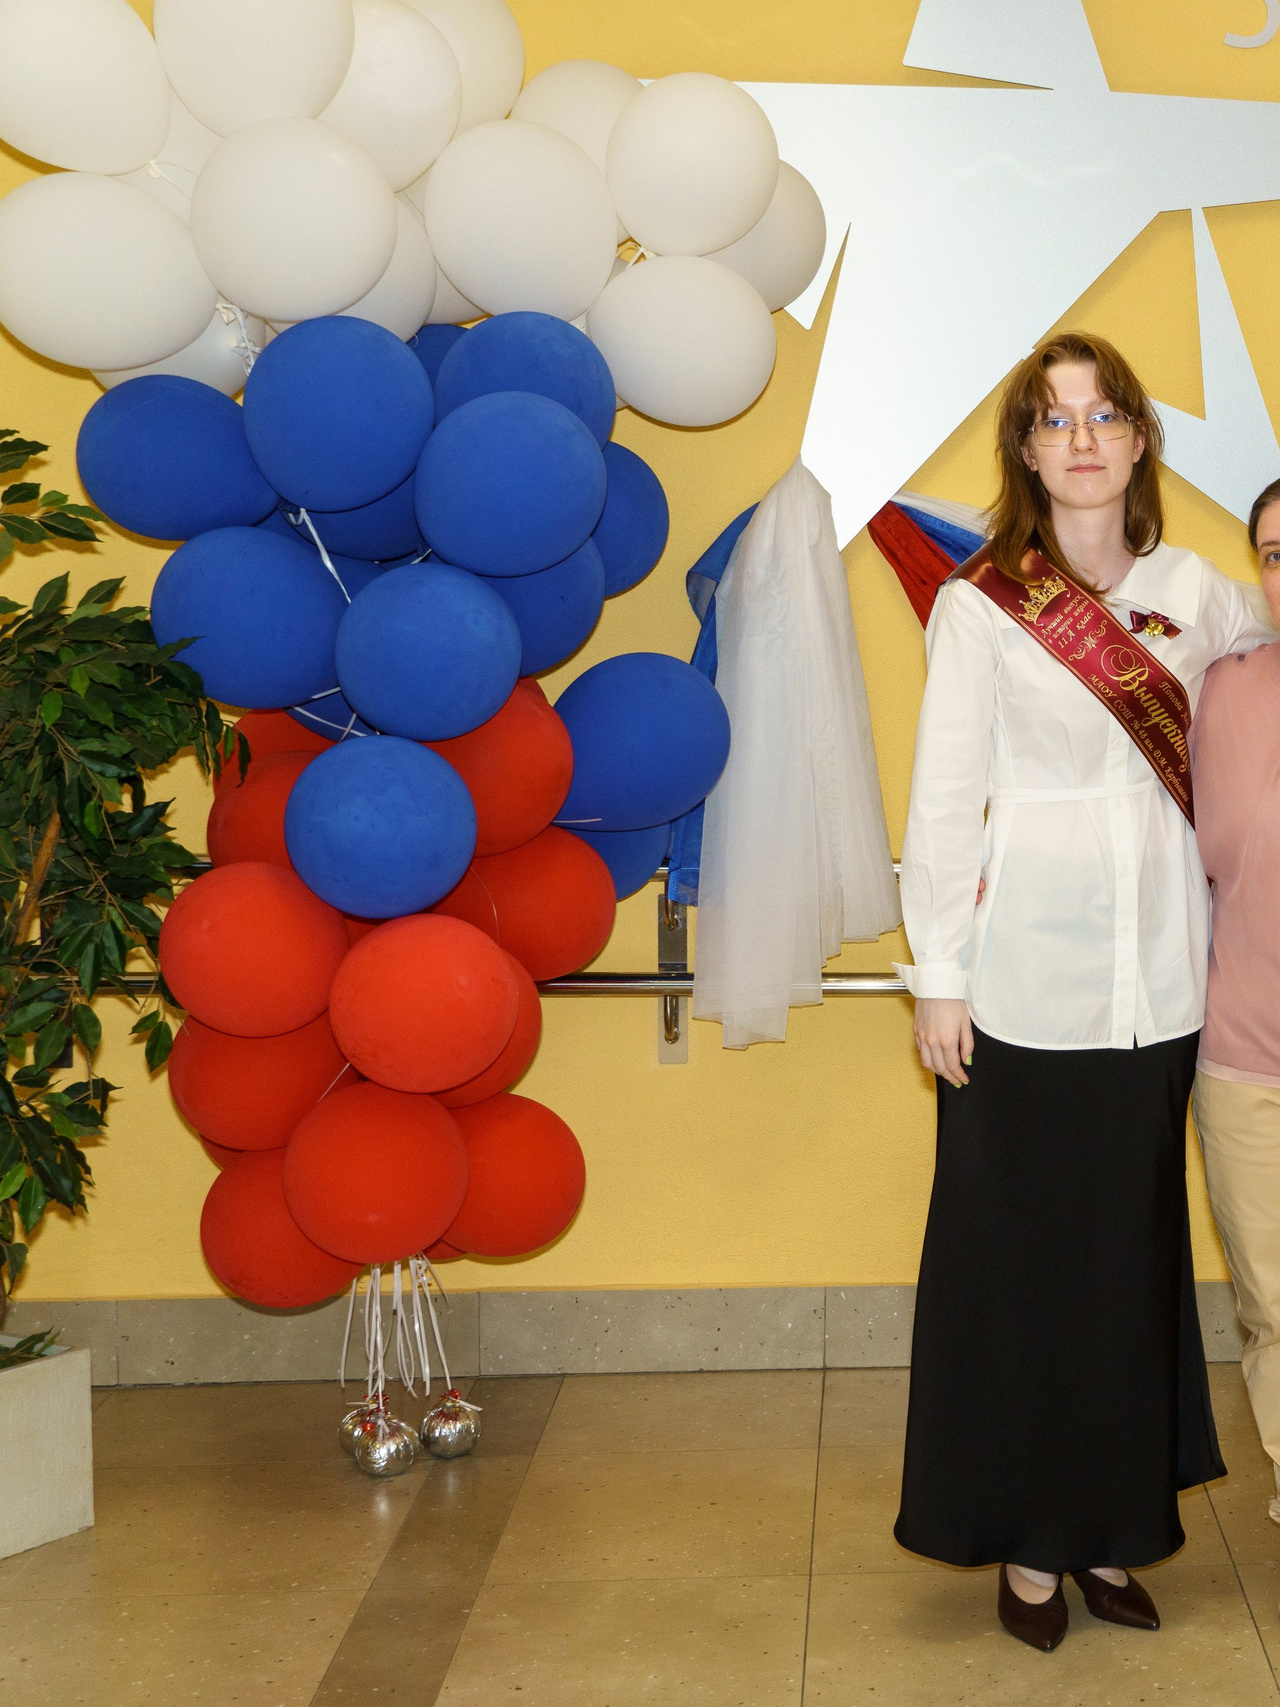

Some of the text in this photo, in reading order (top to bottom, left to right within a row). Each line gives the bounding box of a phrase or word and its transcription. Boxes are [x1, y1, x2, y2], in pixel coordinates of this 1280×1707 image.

[1041, 594, 1085, 638] Лучший выпуск
[1052, 616, 1074, 639] истории
[1058, 637, 1068, 649] 11
[1101, 644, 1190, 776] Выпускниц
[1159, 681, 1183, 711] Попова
[1088, 673, 1117, 698] МАОУ
[1113, 699, 1135, 720] СОШ
[1138, 729, 1149, 739] 48
[1164, 766, 1190, 802] Карбышева
